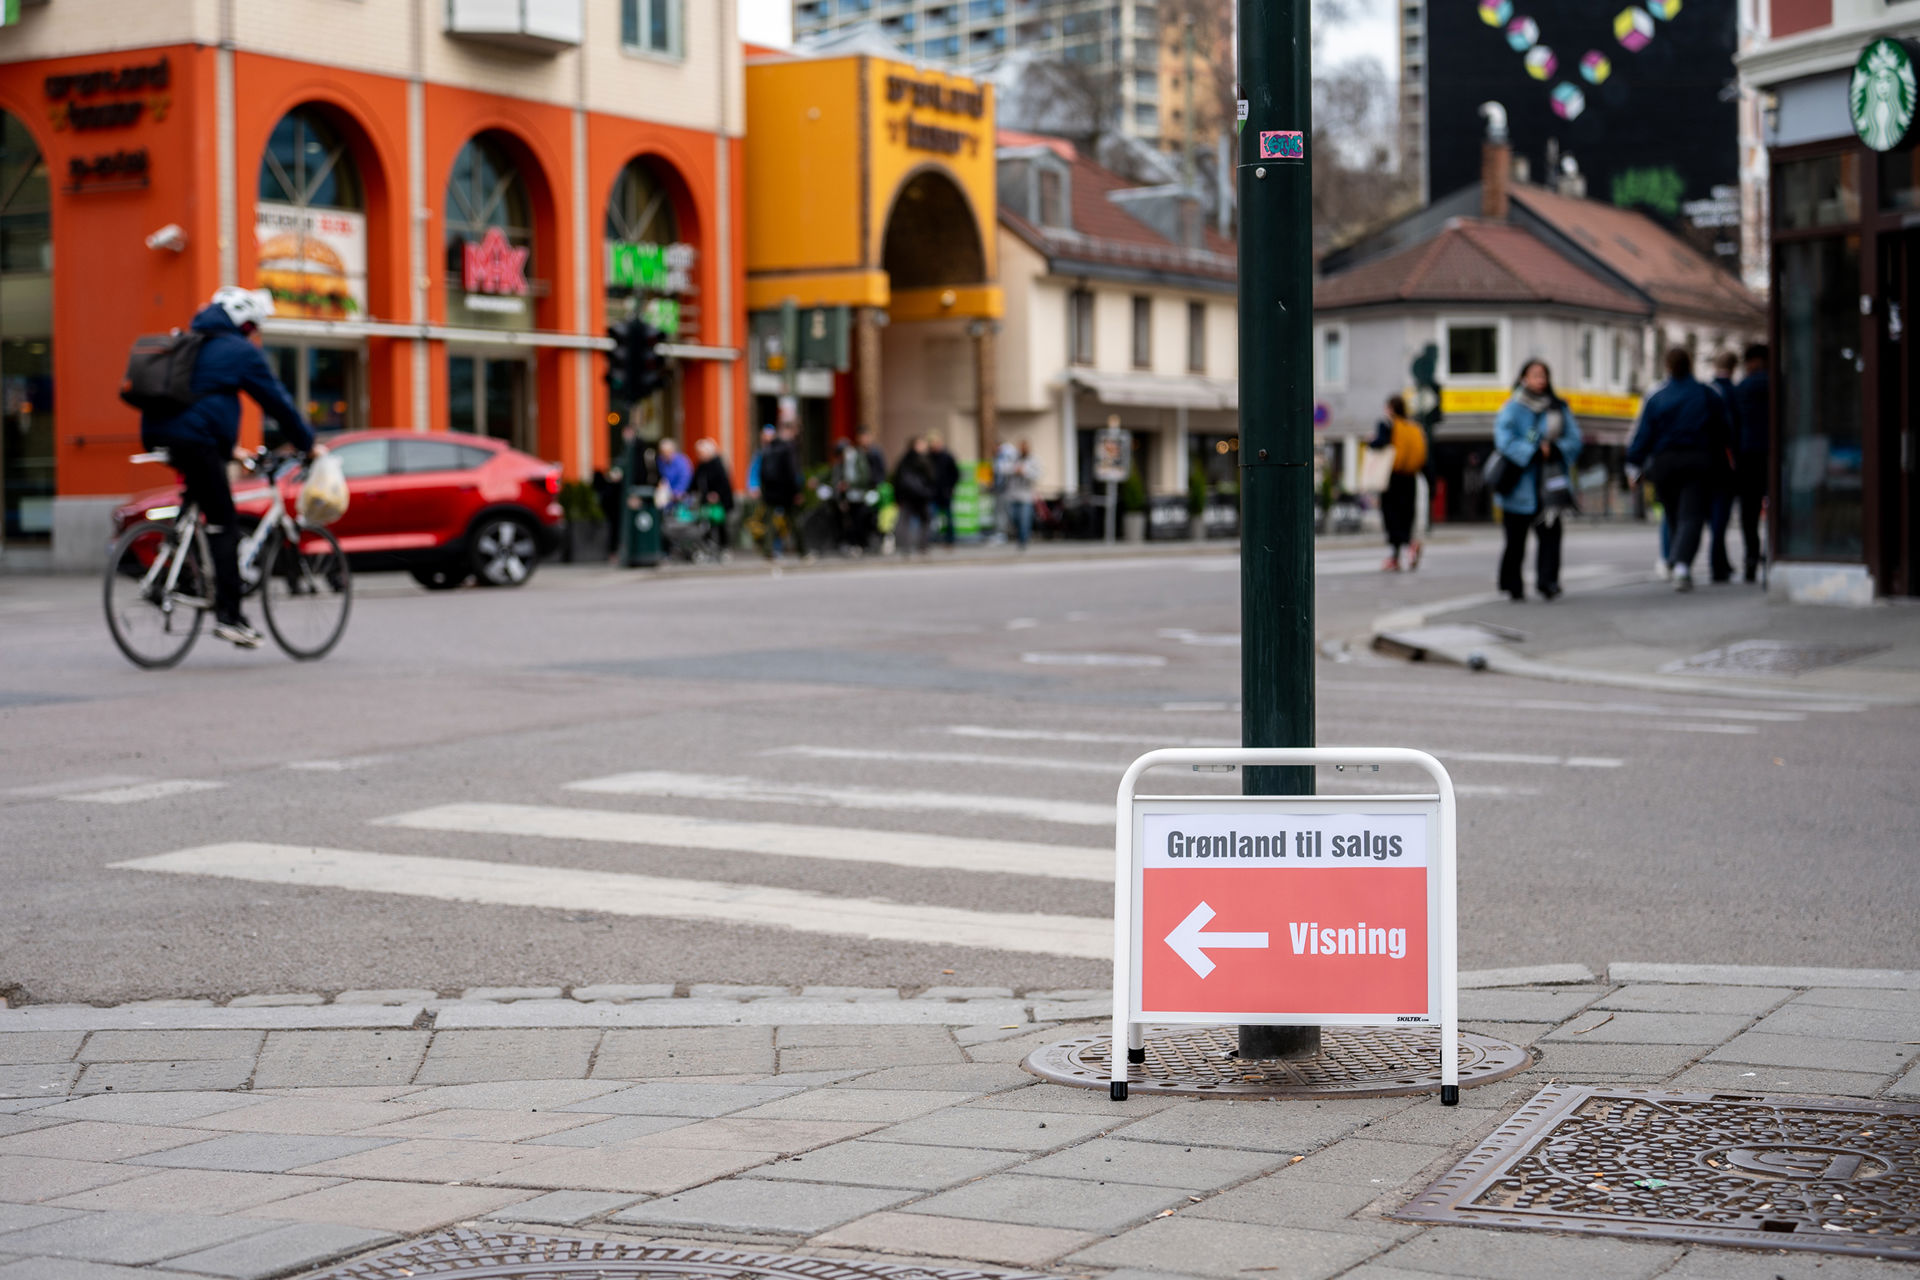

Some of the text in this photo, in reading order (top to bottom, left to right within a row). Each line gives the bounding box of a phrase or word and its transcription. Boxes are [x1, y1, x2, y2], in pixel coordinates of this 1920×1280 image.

[1167, 830, 1403, 861] Grønland til salgs
[1288, 922, 1407, 959] Visning
